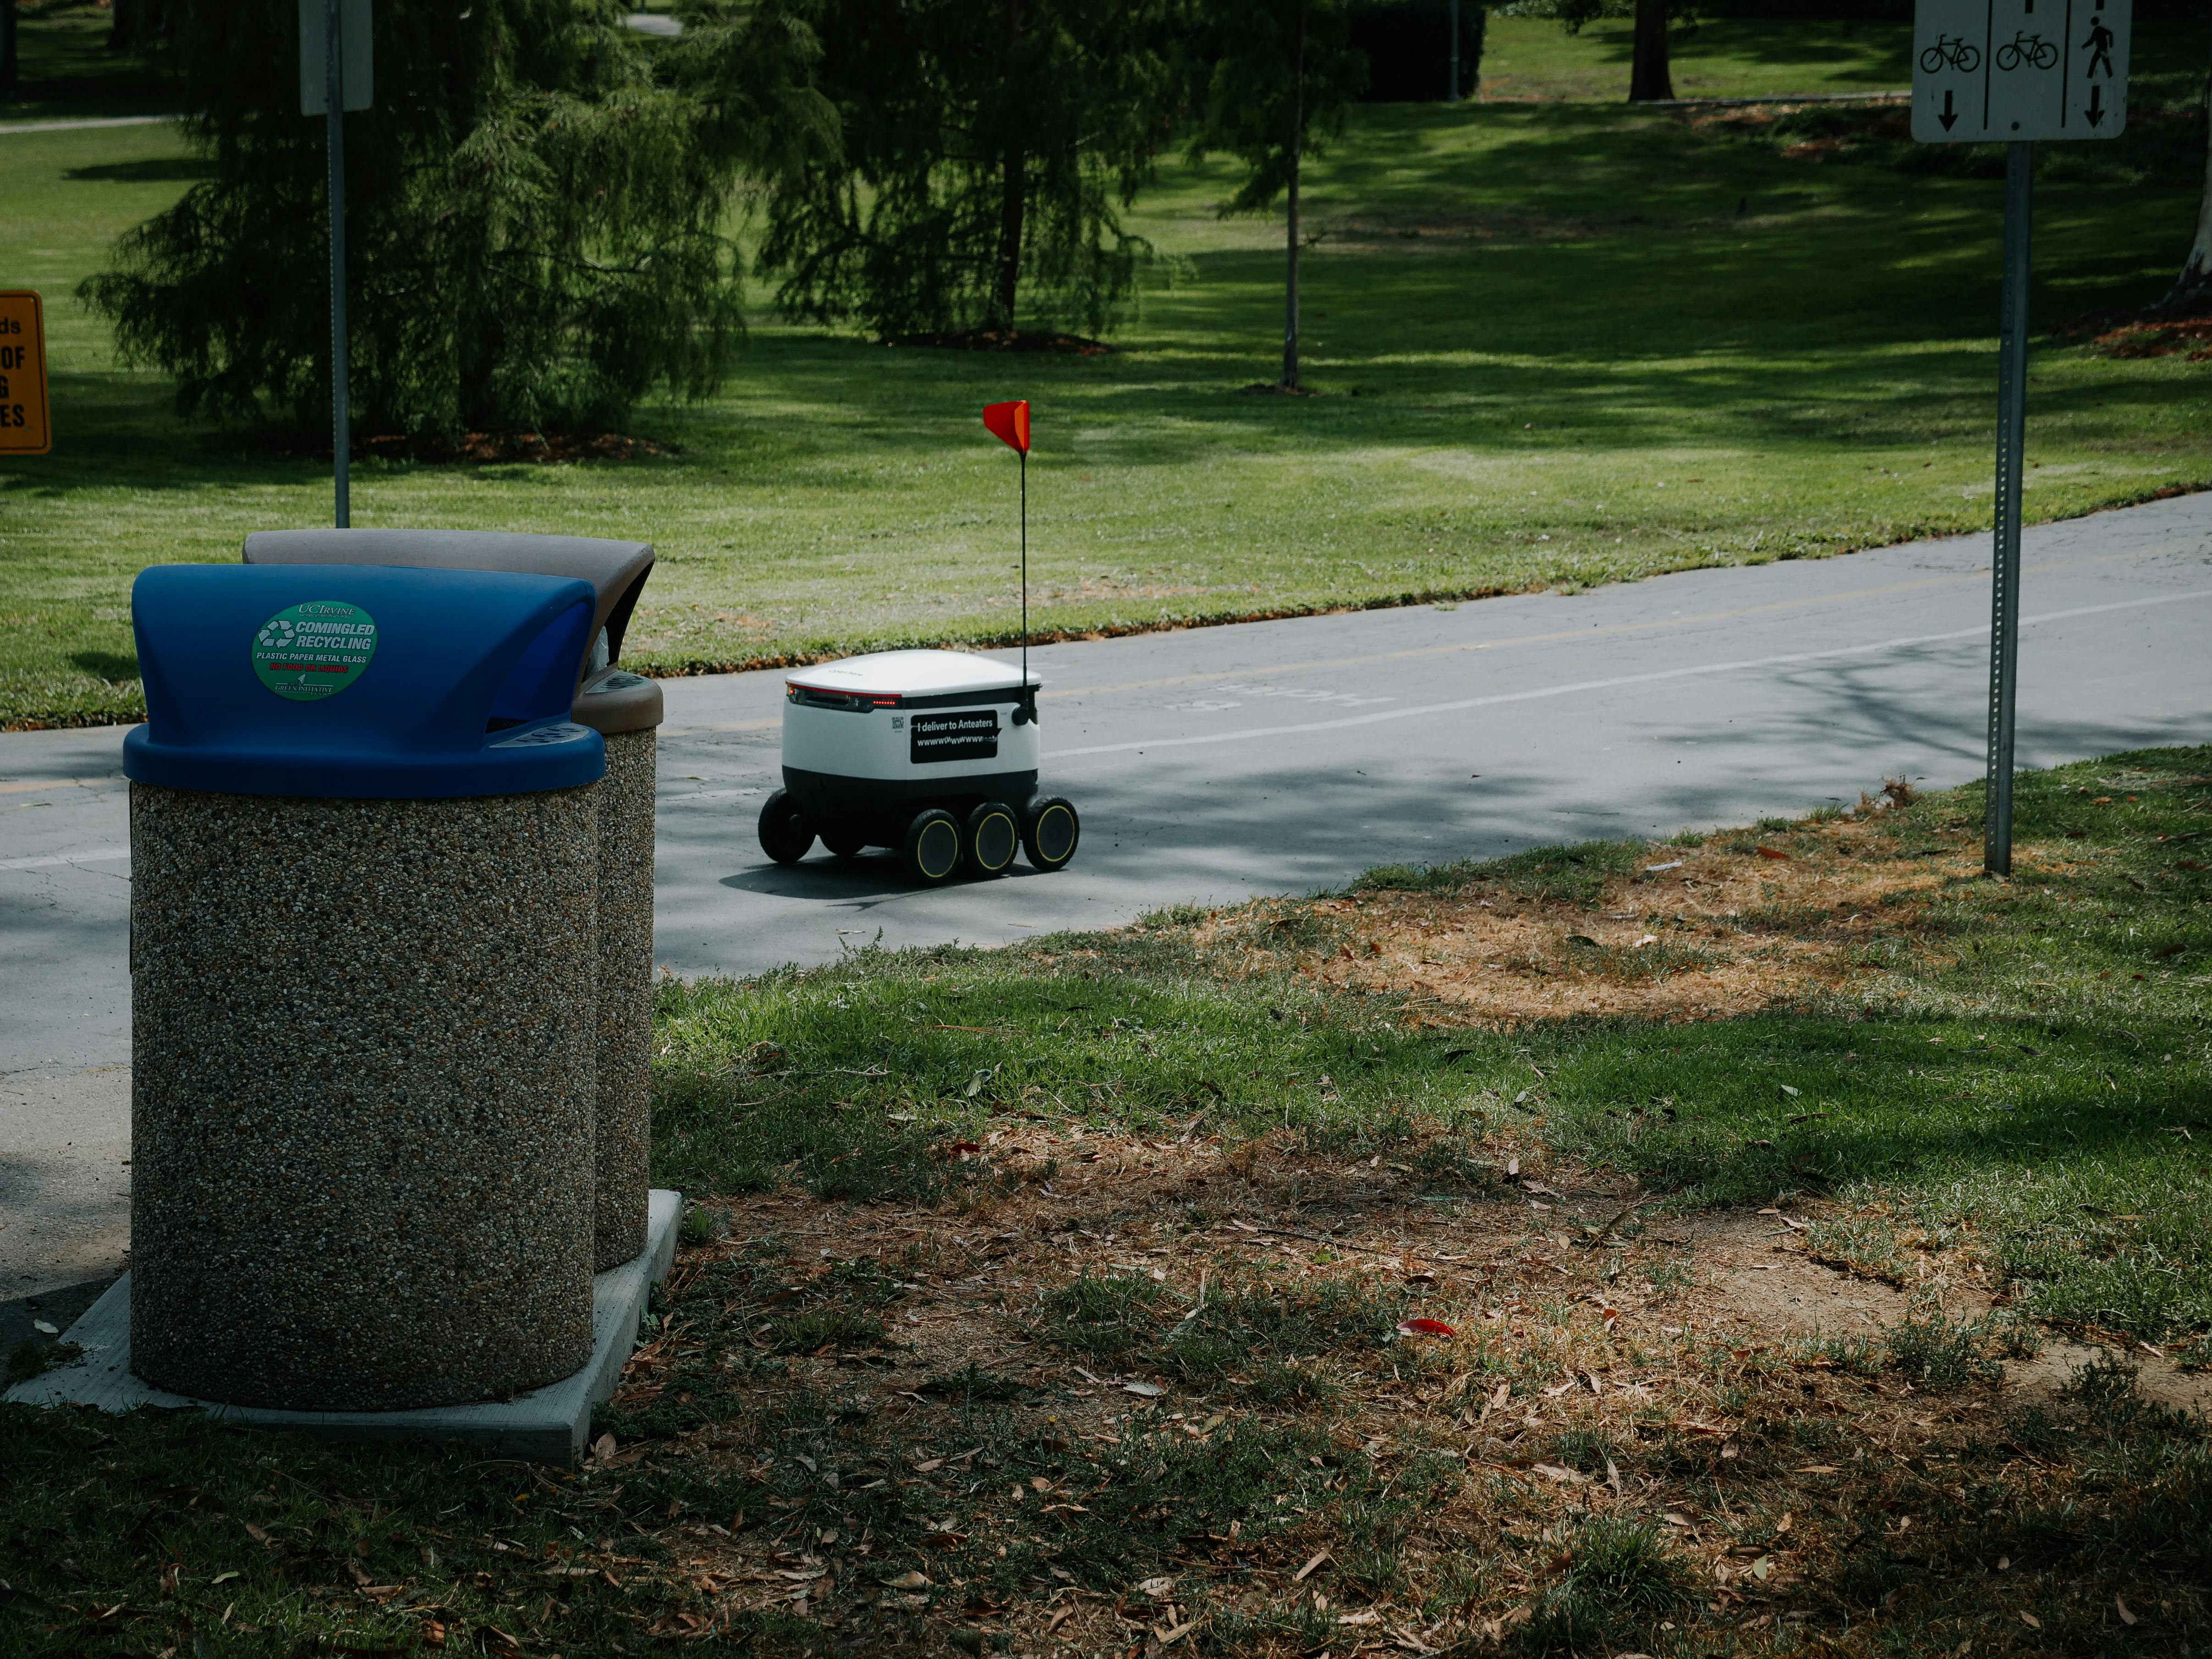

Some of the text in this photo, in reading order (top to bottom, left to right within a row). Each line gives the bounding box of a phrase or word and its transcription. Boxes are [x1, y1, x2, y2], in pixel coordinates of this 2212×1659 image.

[296, 621, 375, 636] COMINGLED
[296, 636, 371, 650] RECYCLING
[257, 652, 288, 660] PLASTIC
[289, 653, 314, 661] PAPER
[918, 719, 993, 732] I deliver to Anteaters
